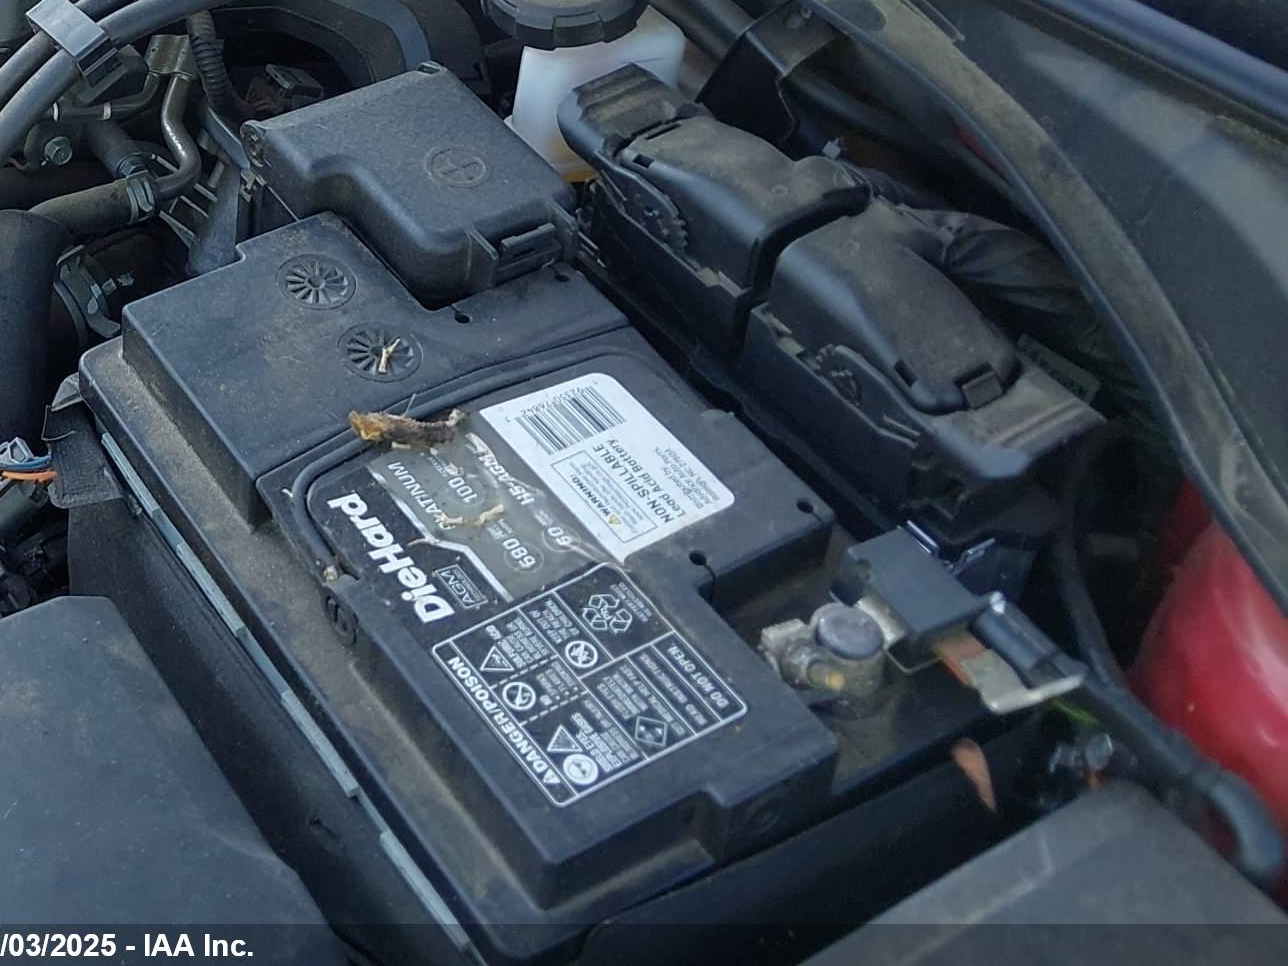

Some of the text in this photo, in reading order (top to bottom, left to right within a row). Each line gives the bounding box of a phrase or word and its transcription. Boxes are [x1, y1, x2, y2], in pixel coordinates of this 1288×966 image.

[605, 438, 644, 472] Battery
[387, 461, 455, 532] PLATINUM
[446, 475, 479, 503] 100
[591, 443, 674, 523] NON-SPILLABLE
[638, 472, 663, 493] Acid
[658, 493, 686, 517] Lead
[546, 525, 572, 546] 60
[327, 491, 453, 624] DieHard
[501, 537, 537, 569] 680
[440, 569, 475, 605] AGM
[690, 670, 715, 692] NOT
[447, 655, 548, 772] DANGER/POISON
[708, 690, 730, 708] DO
